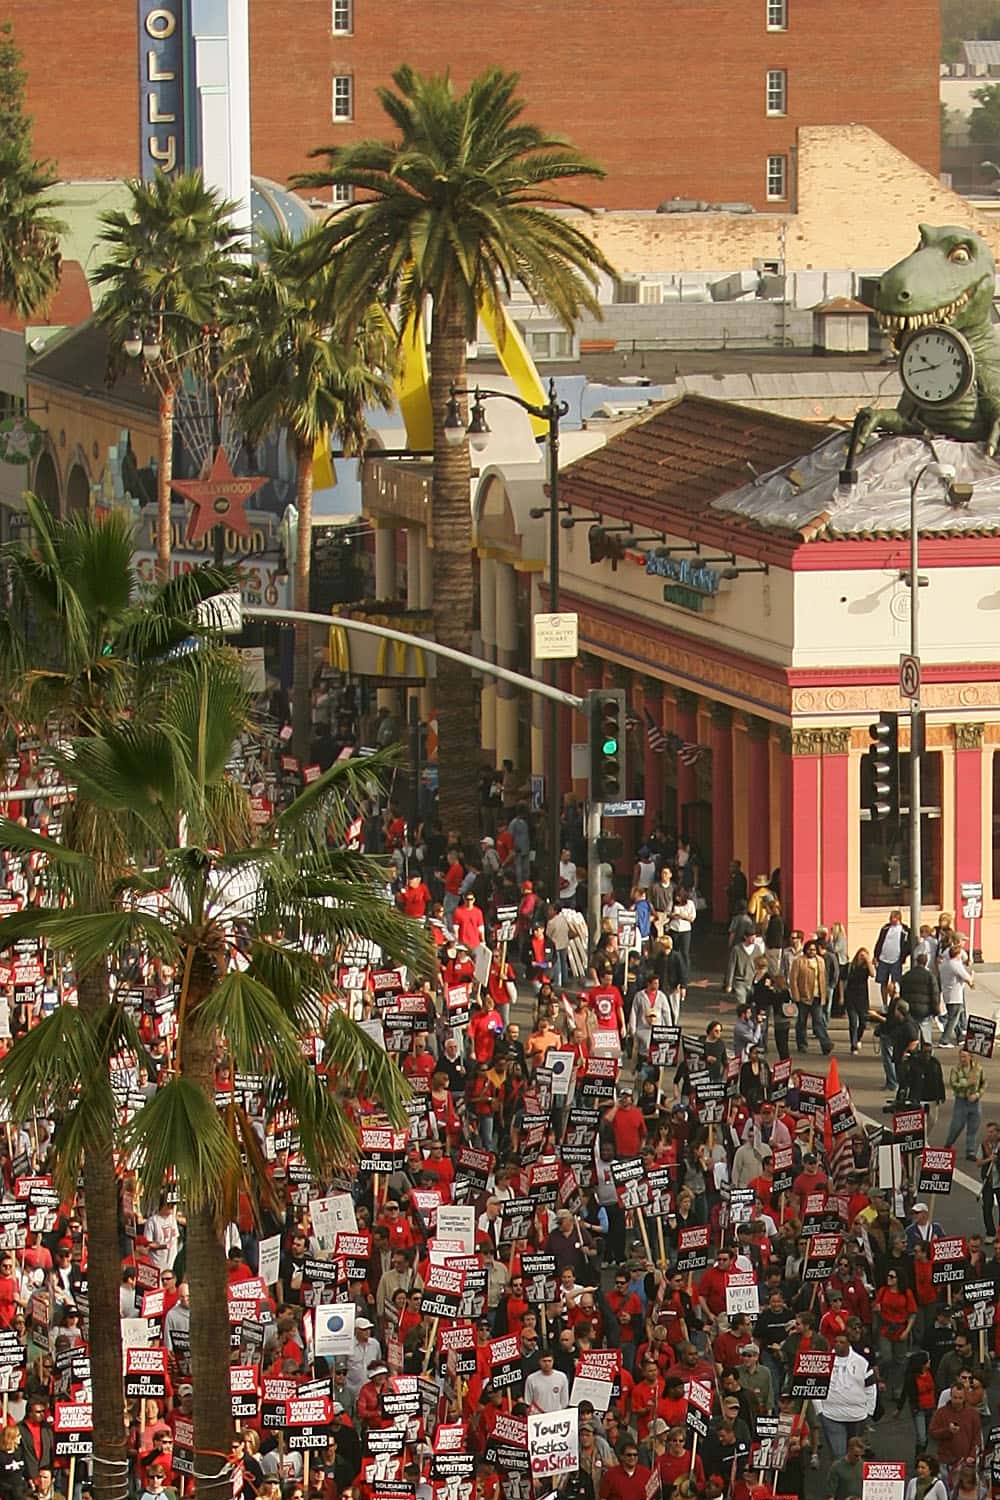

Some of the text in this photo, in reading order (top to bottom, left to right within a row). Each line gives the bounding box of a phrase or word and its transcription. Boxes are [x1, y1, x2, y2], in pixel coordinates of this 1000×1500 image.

[127, 1384, 164, 1395] STRIKE
[533, 1420, 571, 1438] Young
[530, 1440, 569, 1456] Restless
[532, 1453, 578, 1474] On Strike
